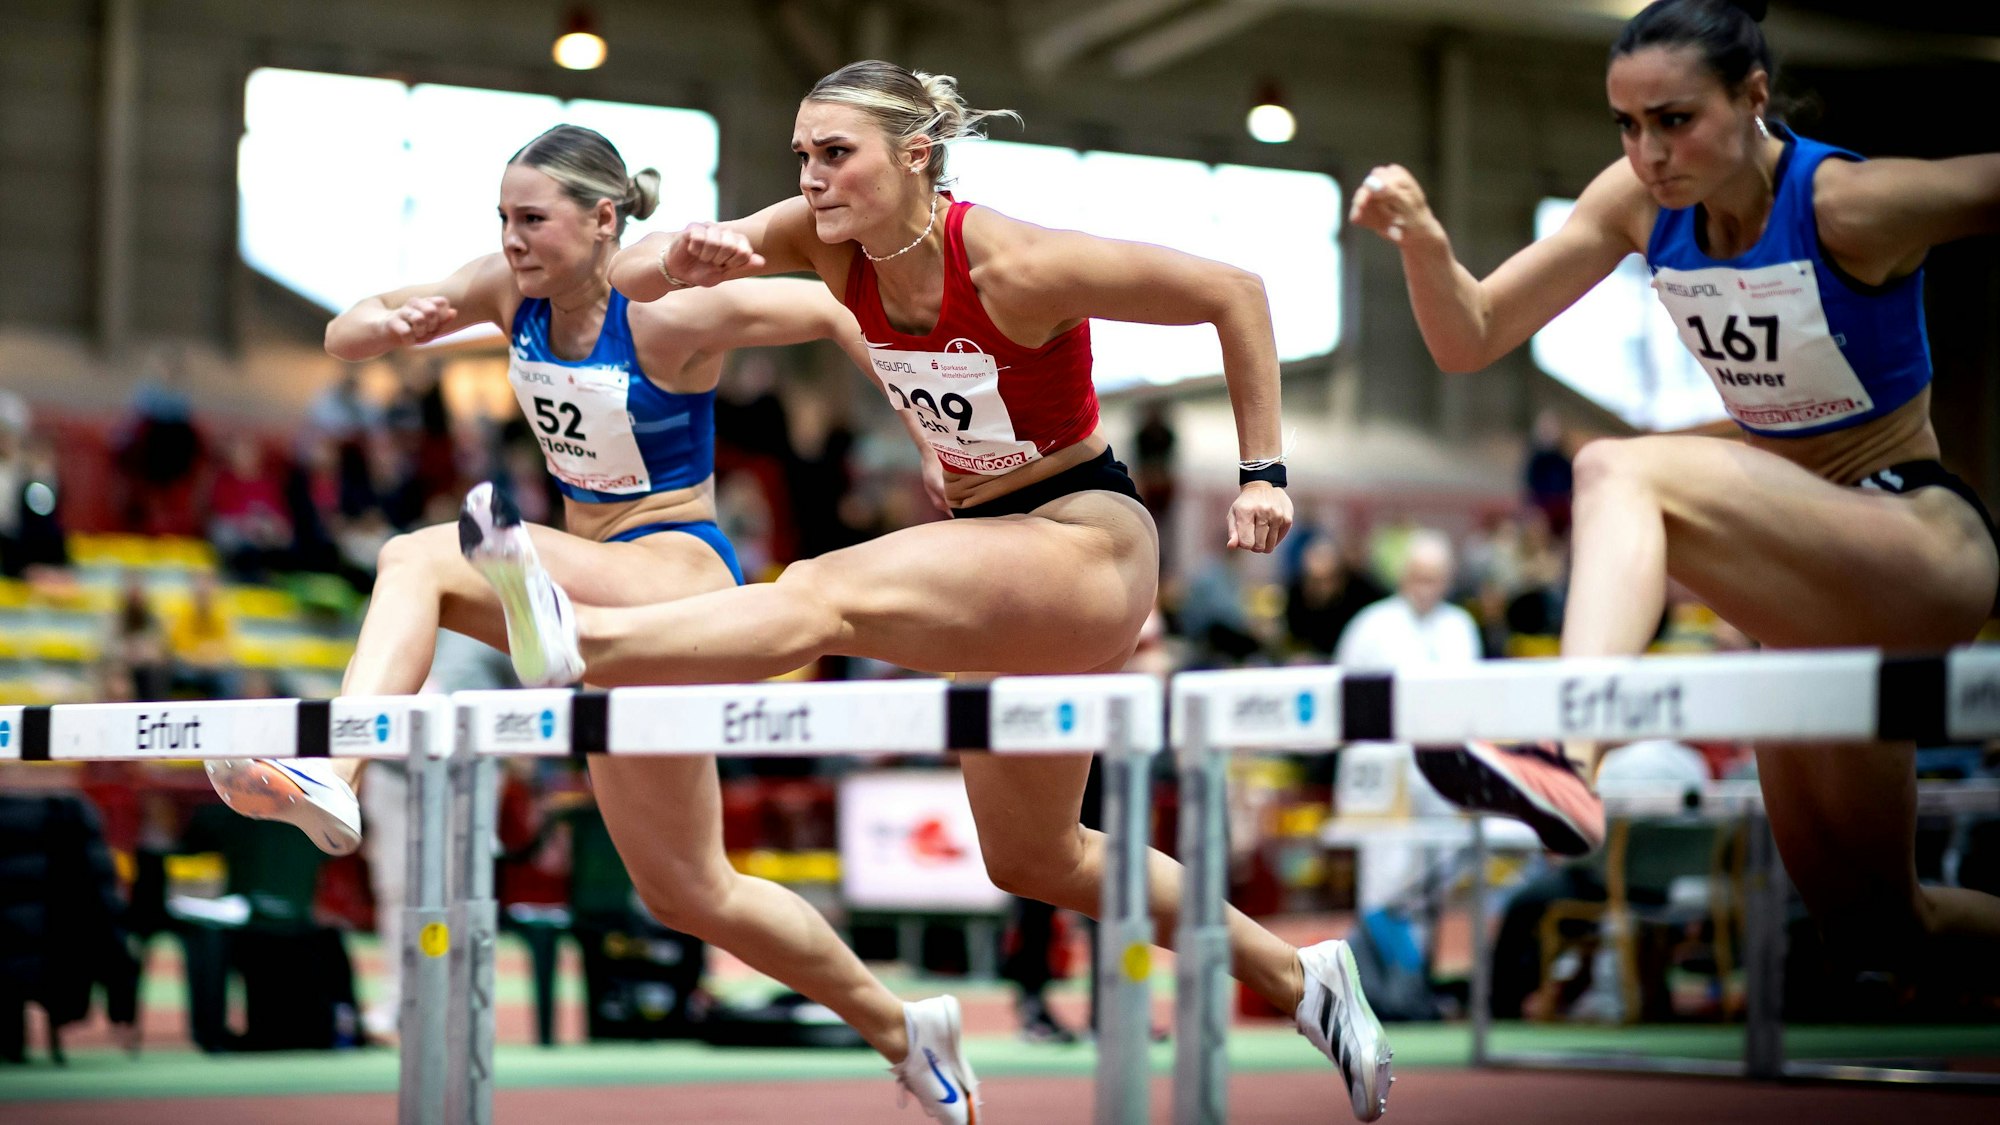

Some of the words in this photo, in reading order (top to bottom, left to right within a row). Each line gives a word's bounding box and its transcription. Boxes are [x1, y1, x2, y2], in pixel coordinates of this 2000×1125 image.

[1687, 315, 1780, 362] 167
[941, 371, 986, 379] Mittelthüringen
[1717, 368, 1786, 387] Never
[533, 396, 587, 441] 52
[974, 453, 1024, 471] INDOOR
[724, 699, 811, 744] Erfurt
[1557, 674, 1683, 730] Erfurt
[137, 712, 202, 750] Erfurt
